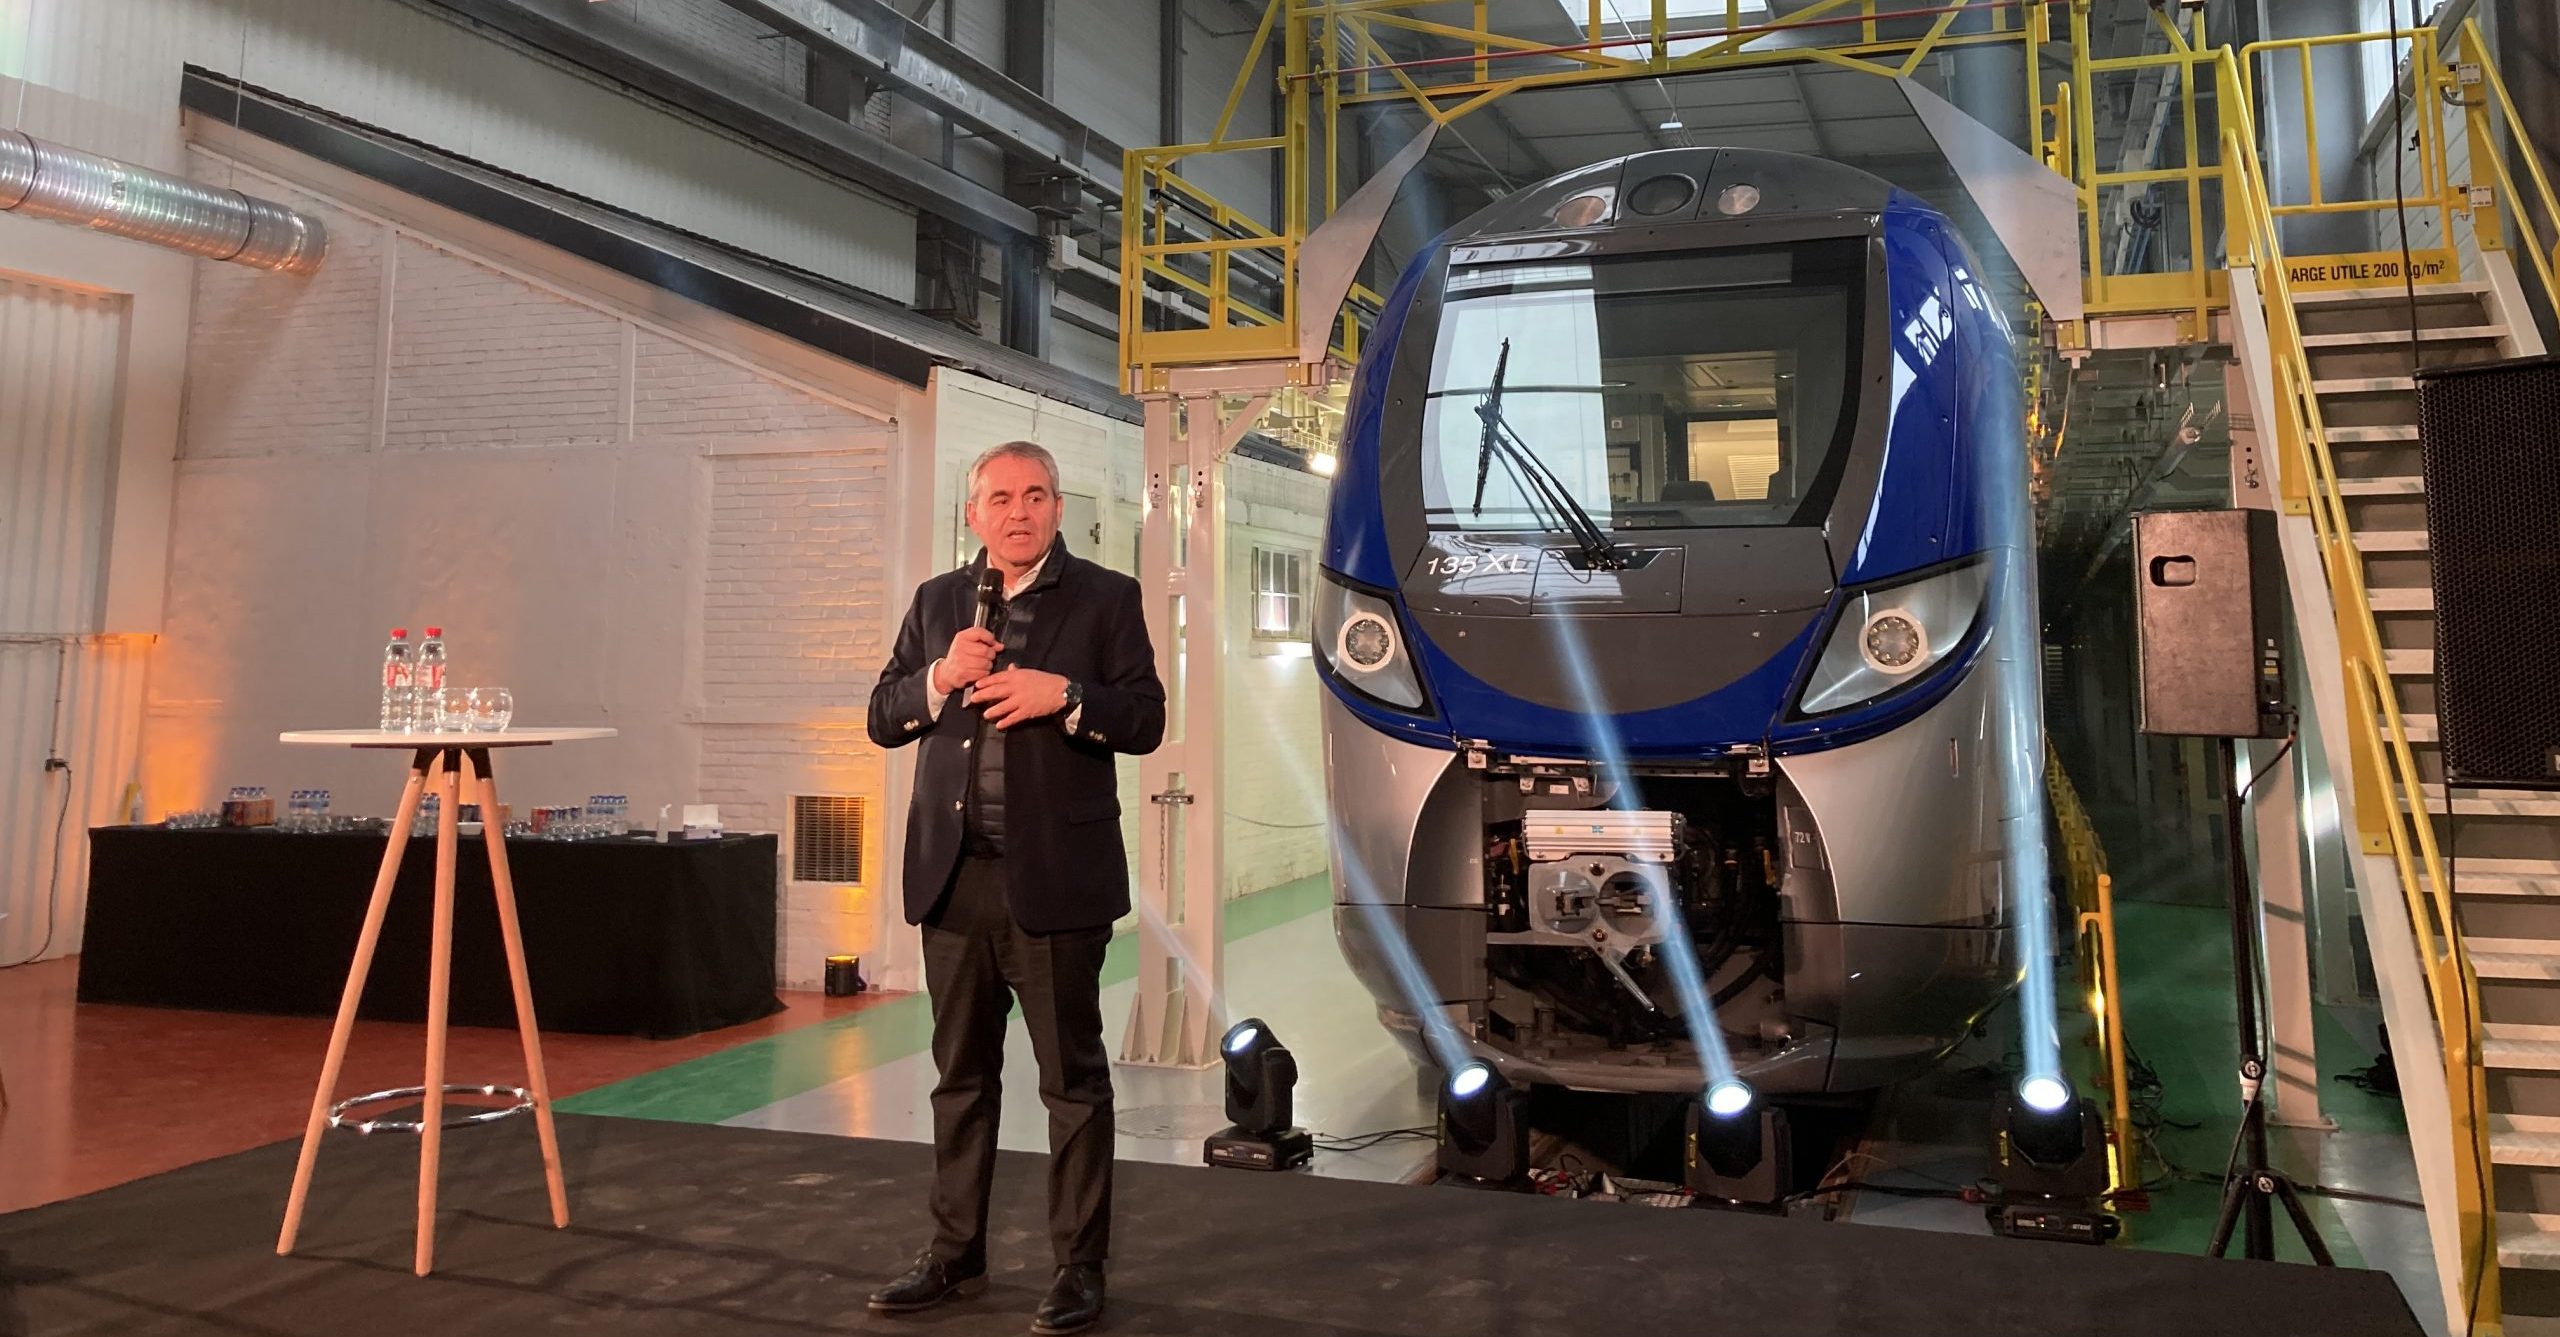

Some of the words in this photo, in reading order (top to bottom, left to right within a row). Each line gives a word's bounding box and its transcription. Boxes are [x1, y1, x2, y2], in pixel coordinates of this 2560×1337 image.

[2290, 266, 2327, 282] ARGE
[2331, 264, 2369, 280] UTILE
[2374, 262, 2399, 278] 200
[1427, 556, 1479, 575] 135
[1483, 553, 1528, 573] XL
